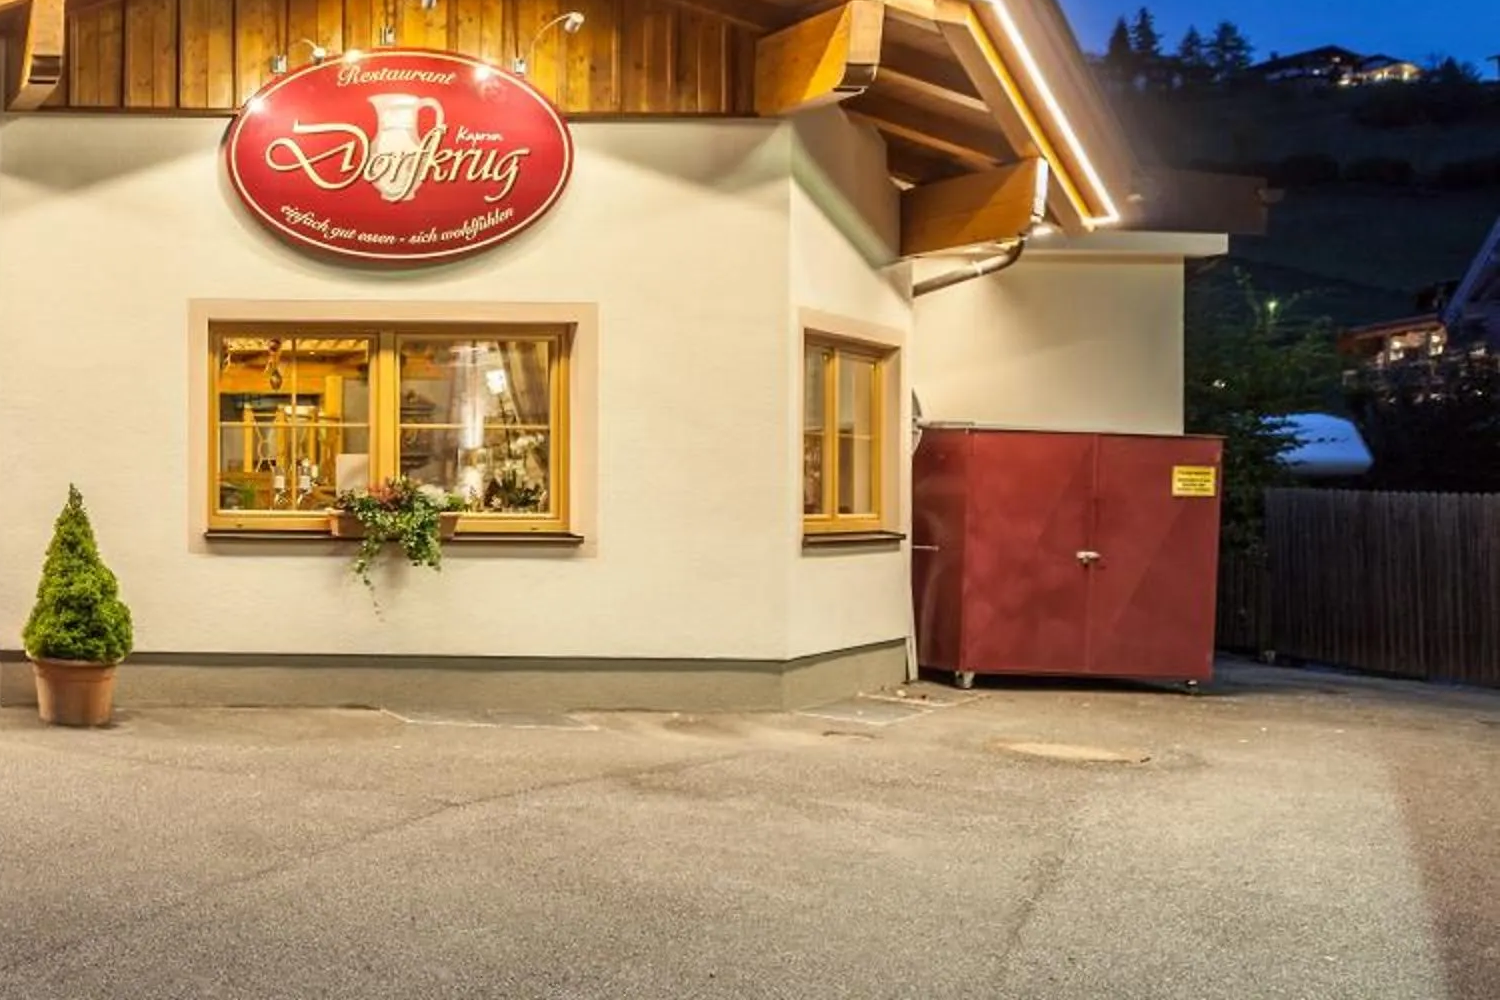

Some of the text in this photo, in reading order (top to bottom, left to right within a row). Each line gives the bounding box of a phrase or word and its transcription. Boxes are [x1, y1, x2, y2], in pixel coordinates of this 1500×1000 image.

[337, 66, 457, 87] Restaurant
[265, 119, 530, 202] Dorfkrug
[280, 204, 329, 234] einfach
[325, 226, 356, 241] gut
[358, 230, 396, 245] essen
[408, 226, 438, 244] sich
